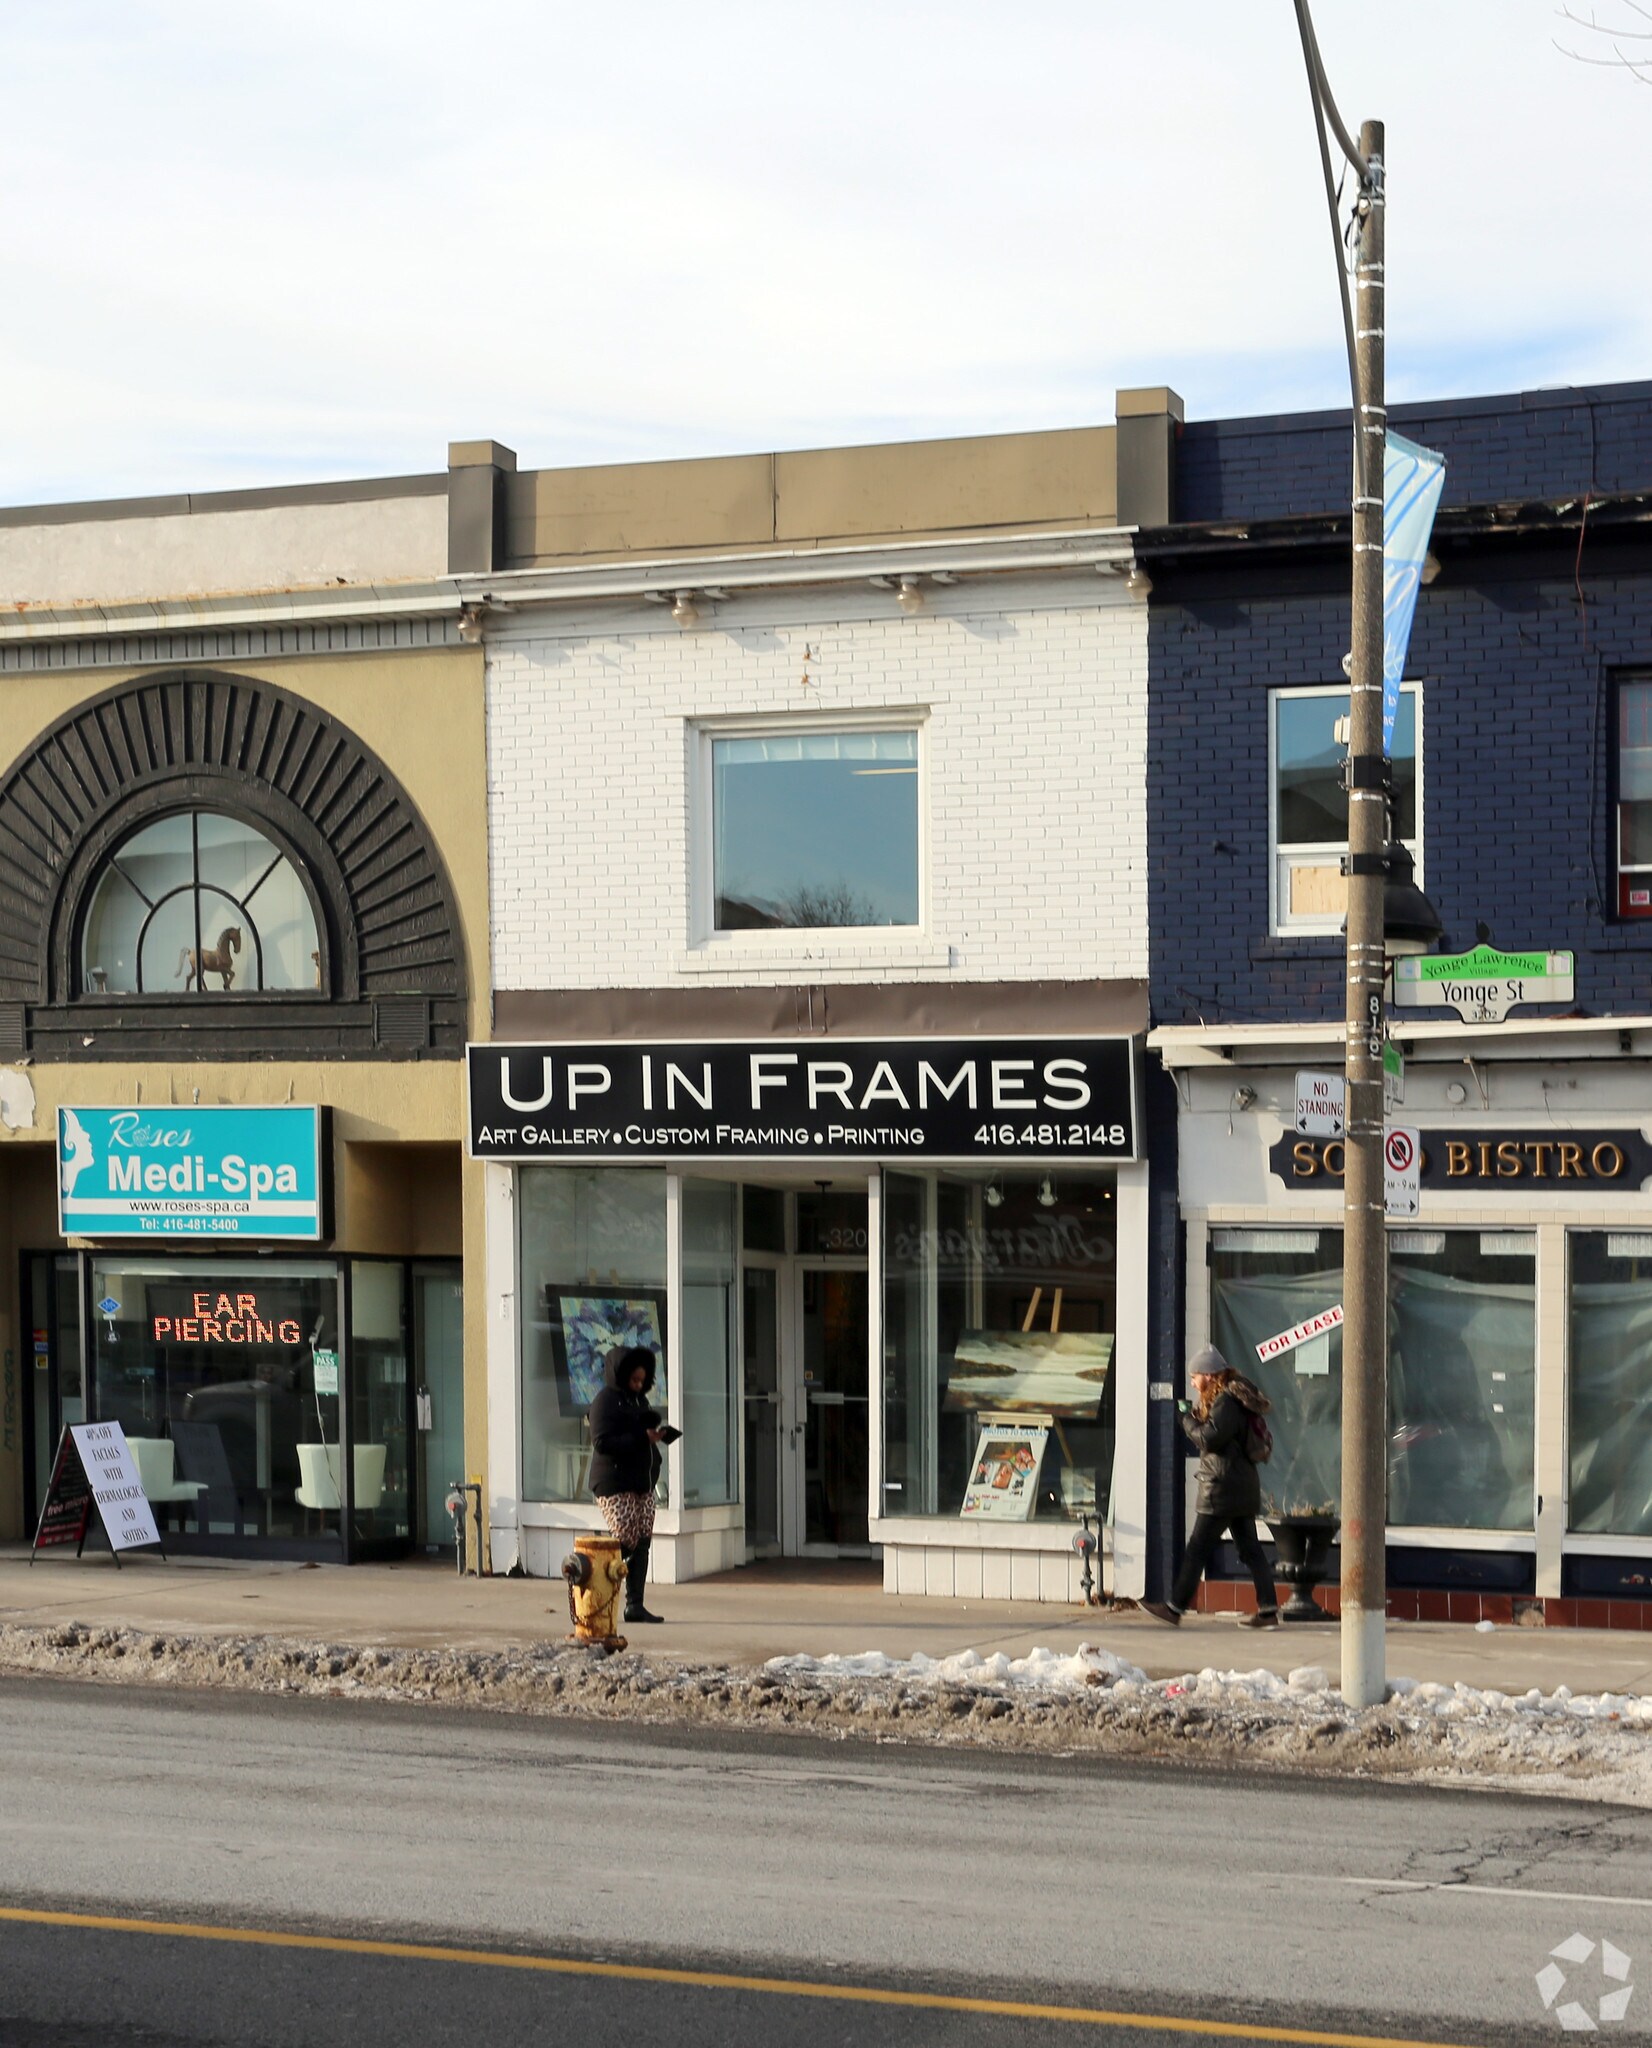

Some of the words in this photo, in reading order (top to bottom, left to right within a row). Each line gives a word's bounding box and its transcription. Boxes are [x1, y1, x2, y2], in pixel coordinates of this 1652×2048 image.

[1425, 957, 1469, 977] Yonge
[1473, 953, 1543, 973] Lawrence
[1468, 967, 1499, 976] Village
[1441, 981, 1498, 1008] Yonge
[1506, 980, 1524, 1001] St
[501, 1056, 611, 1112] UP
[642, 1055, 712, 1111] IN
[750, 1053, 1091, 1111] FRAMES
[1313, 1081, 1328, 1097] NO
[1298, 1099, 1343, 1117] STANDING
[478, 1126, 517, 1144] ART
[521, 1125, 611, 1144] GALLERY
[625, 1124, 710, 1144] CUSTOM
[716, 1124, 809, 1144] FRAMING
[828, 1125, 925, 1145] PRINTING
[974, 1124, 1126, 1145] 416.481.2148
[1445, 1141, 1625, 1178] BISTRO
[107, 1154, 298, 1200] Medi-Spa
[130, 1200, 250, 1214] www.roses-spa.ca
[139, 1217, 160, 1230] Tel:
[163, 1218, 239, 1231] 416-481-5400
[193, 1293, 260, 1320] EAR
[154, 1317, 301, 1344] PIERCING
[1260, 1336, 1290, 1358] FOR
[1294, 1308, 1342, 1340] LEASE
[316, 1355, 335, 1366] PASS
[98, 1425, 112, 1439] OFF
[91, 1446, 121, 1461] FACIALS
[103, 1467, 124, 1480] WITH
[95, 1484, 145, 1503] DERMALOGICA
[121, 1508, 135, 1521] AND
[122, 1527, 149, 1543] SOTHYS
